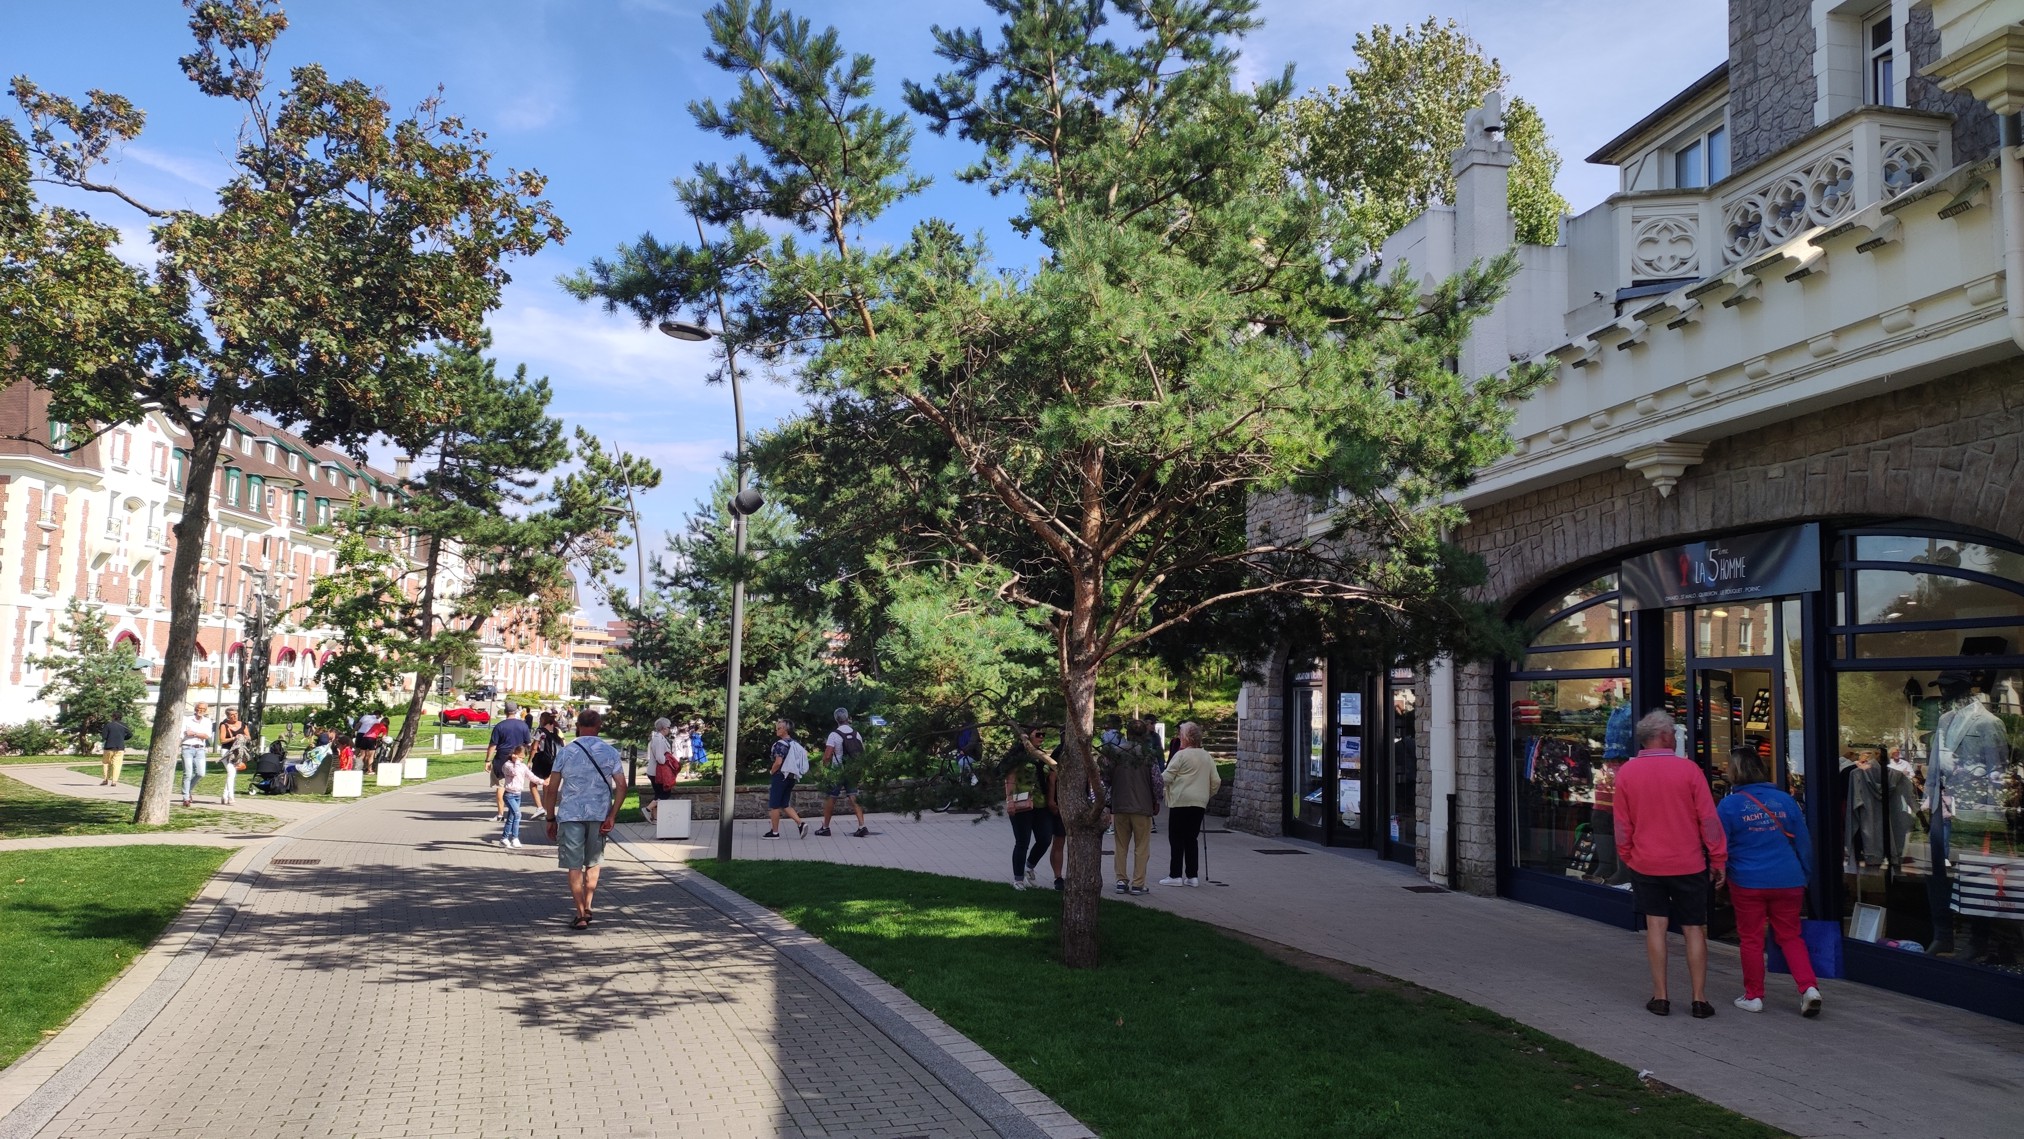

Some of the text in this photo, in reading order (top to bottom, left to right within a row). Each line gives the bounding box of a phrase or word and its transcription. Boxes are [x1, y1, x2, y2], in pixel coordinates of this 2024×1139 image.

[1695, 561, 1706, 584] LA
[1719, 556, 1746, 580] HOMME
[1742, 812, 1763, 822] YACHT
